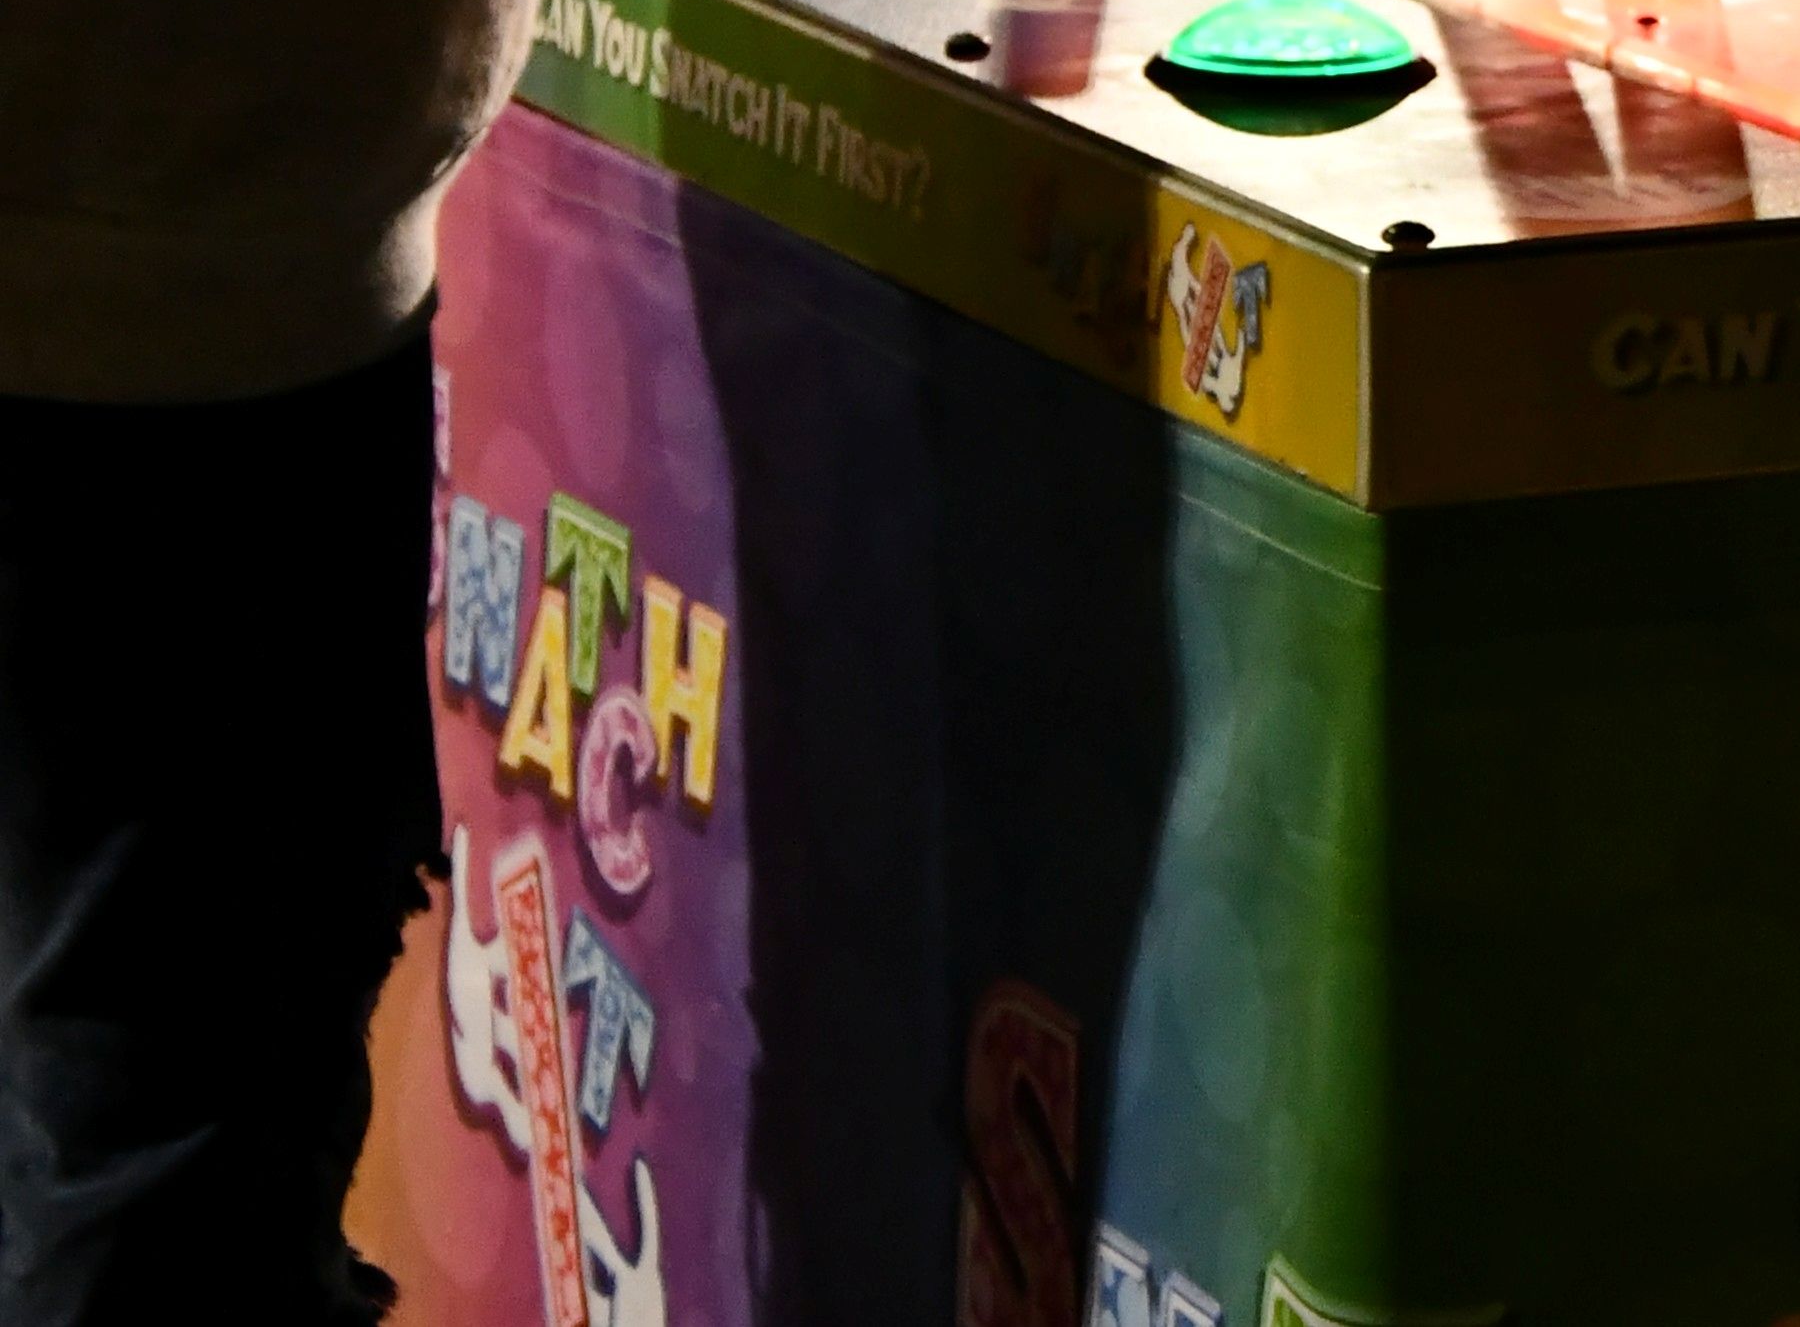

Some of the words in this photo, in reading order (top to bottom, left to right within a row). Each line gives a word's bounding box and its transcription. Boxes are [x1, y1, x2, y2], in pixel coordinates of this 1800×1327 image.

[649, 27, 770, 146] SNATCH
[775, 82, 811, 167] IT
[816, 101, 931, 223] FIRST?
[1604, 311, 1783, 391] CAN
[428, 365, 730, 895] NATCH
